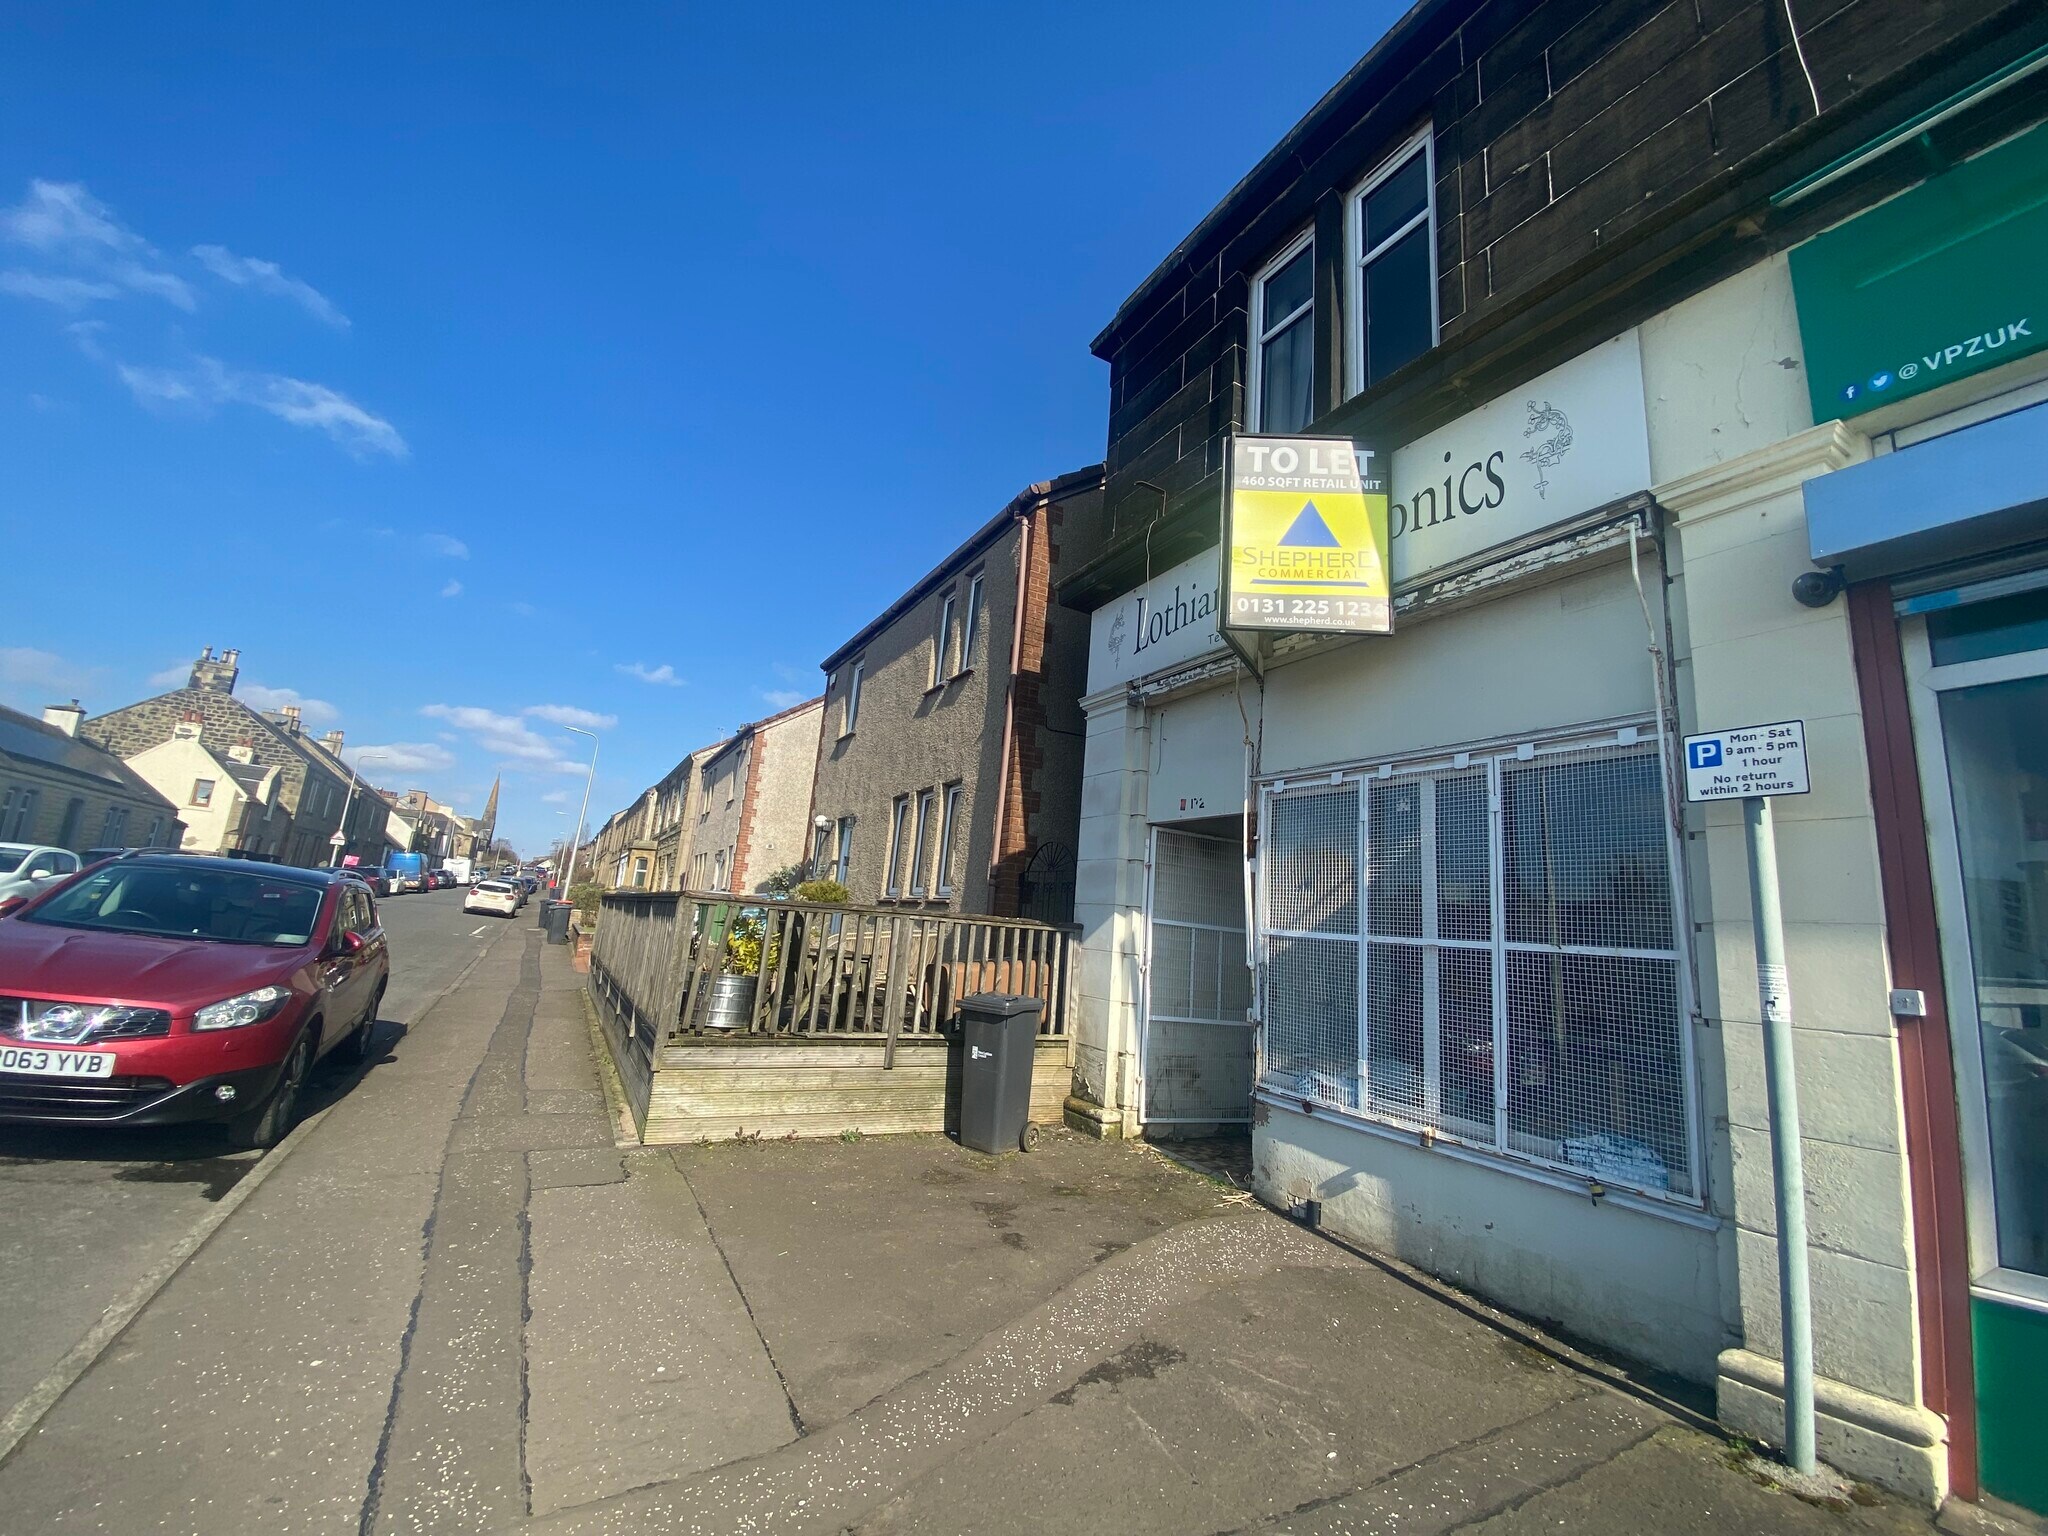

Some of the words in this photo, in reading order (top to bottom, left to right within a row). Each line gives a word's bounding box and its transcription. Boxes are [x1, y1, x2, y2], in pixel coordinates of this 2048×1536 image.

[1247, 446, 1298, 474] TO
[1310, 448, 1375, 476] LET
[1242, 476, 1264, 487] 460
[1268, 477, 1301, 489] SQFT
[1303, 478, 1347, 489] RETAIL
[1350, 479, 1381, 490] UNIT
[1242, 546, 1375, 568] SHEPHERD
[1258, 568, 1361, 580] COMMERCIAL
[1237, 598, 1285, 614] 0131
[1292, 599, 1329, 614] 225
[1335, 600, 1385, 618] 1234
[1264, 616, 1356, 627] www.shepherd.co.uk
[1730, 733, 1757, 743] Mon
[1768, 728, 1792, 738] Sat
[1697, 744, 1716, 766] P
[1725, 747, 1733, 755] 9
[1736, 746, 1755, 754] am
[1766, 742, 1774, 751] 5
[1778, 741, 1798, 751] pm
[1742, 758, 1747, 767] 1
[1752, 756, 1782, 766] hour
[1713, 775, 1731, 784] No
[1736, 771, 1777, 782] return
[1700, 785, 1738, 796] within
[1743, 783, 1751, 792] 2
[1756, 781, 1794, 791] hours
[58, 1053, 103, 1073] YVB
